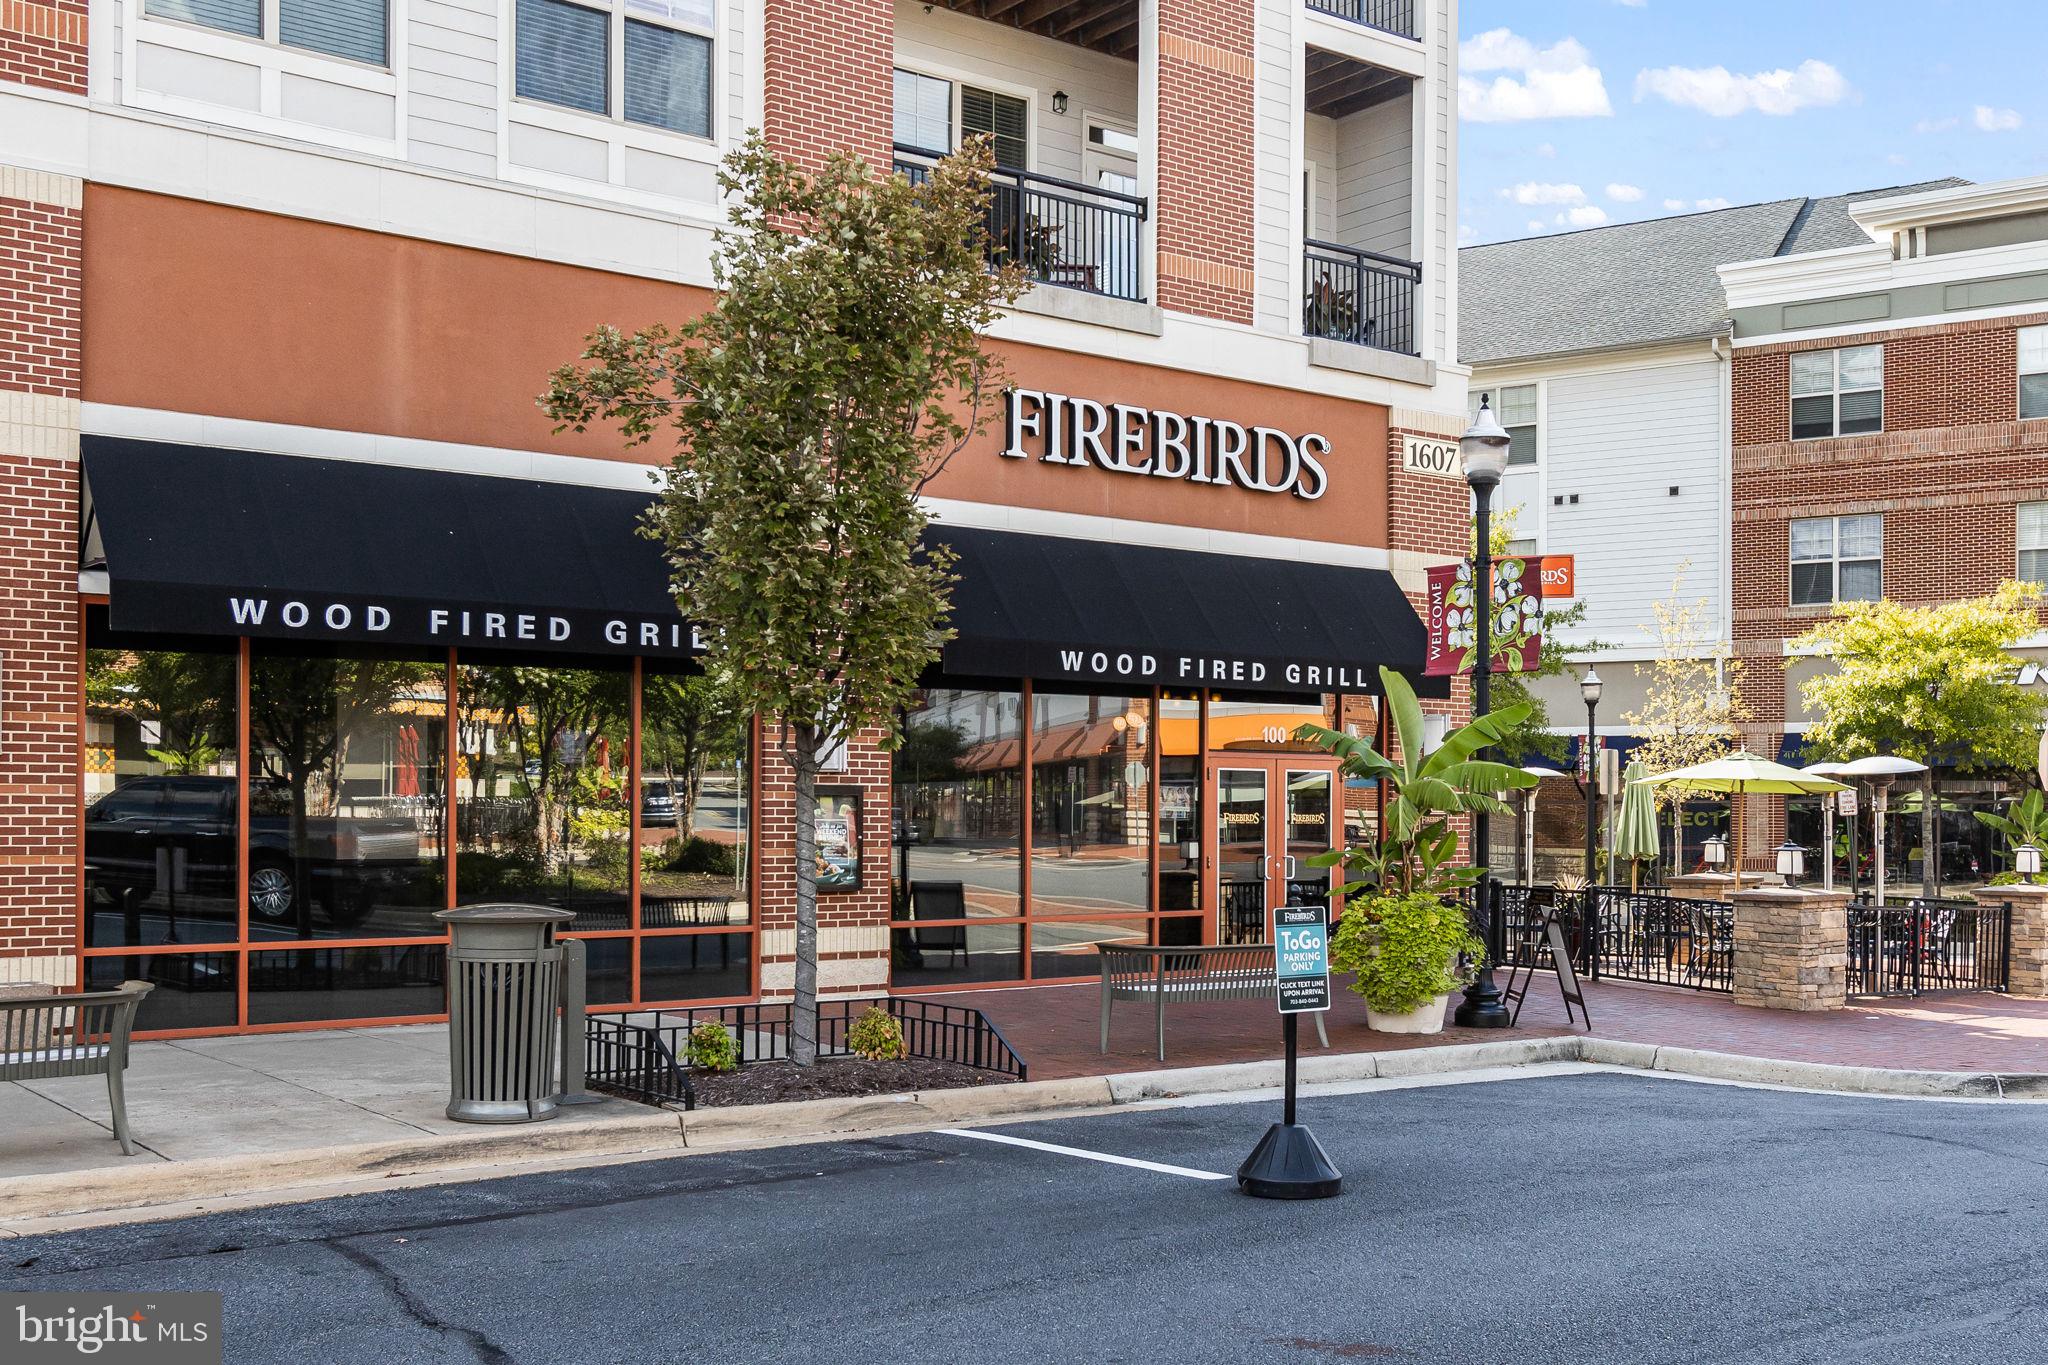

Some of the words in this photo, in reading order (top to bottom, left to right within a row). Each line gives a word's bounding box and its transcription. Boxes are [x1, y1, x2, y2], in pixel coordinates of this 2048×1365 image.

[1409, 442, 1457, 473] 1607
[1541, 567, 1568, 585] RDS
[230, 598, 391, 631] WOOD
[430, 609, 571, 641] FIRED
[1430, 582, 1443, 661] WELCOME
[1060, 650, 1157, 675] WOOD
[1180, 657, 1266, 682] FIRED
[1285, 664, 1367, 687] GRILL
[1262, 726, 1287, 744] 100
[1223, 812, 1260, 825] FIREBIRDS
[1290, 813, 1325, 825] FIREBIRDS
[1285, 911, 1315, 922] FIREBIRDS
[1283, 952, 1321, 963] PARKING
[1291, 961, 1314, 972] ONLY
[1280, 981, 1297, 989] CLICK
[1297, 980, 1311, 988] TEXT
[1311, 979, 1325, 987] LINK
[1283, 989, 1301, 997] UPON
[1301, 988, 1325, 996] ARRIVAL
